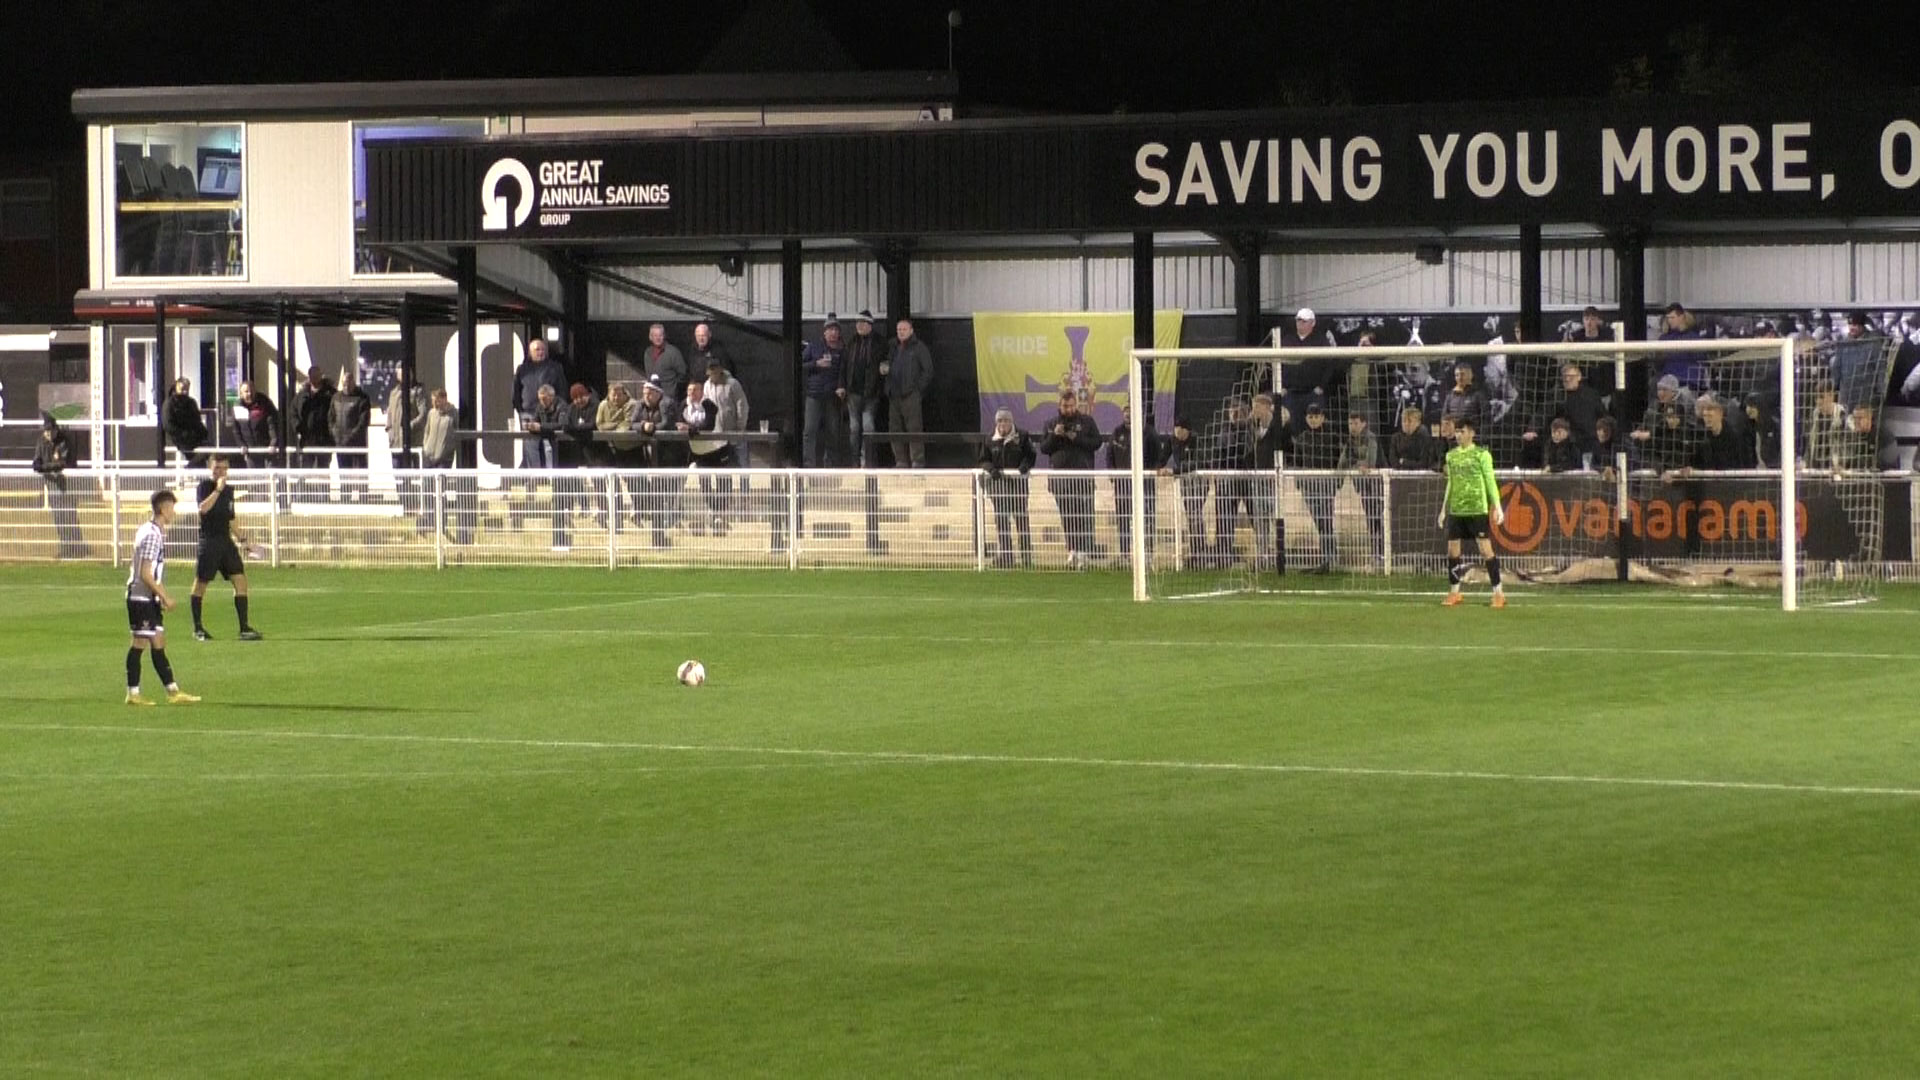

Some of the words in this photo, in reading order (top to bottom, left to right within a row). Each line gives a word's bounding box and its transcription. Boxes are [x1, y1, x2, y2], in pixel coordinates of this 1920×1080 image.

[539, 160, 603, 185] GREAT
[1134, 136, 1382, 206] SAVING
[1418, 130, 1558, 199] YOU
[1602, 122, 1835, 200] MORE,
[540, 186, 603, 206] ANNUAL
[605, 184, 670, 204] SAVINGS
[540, 214, 571, 225] GROUP
[990, 336, 1049, 356] PRIDE
